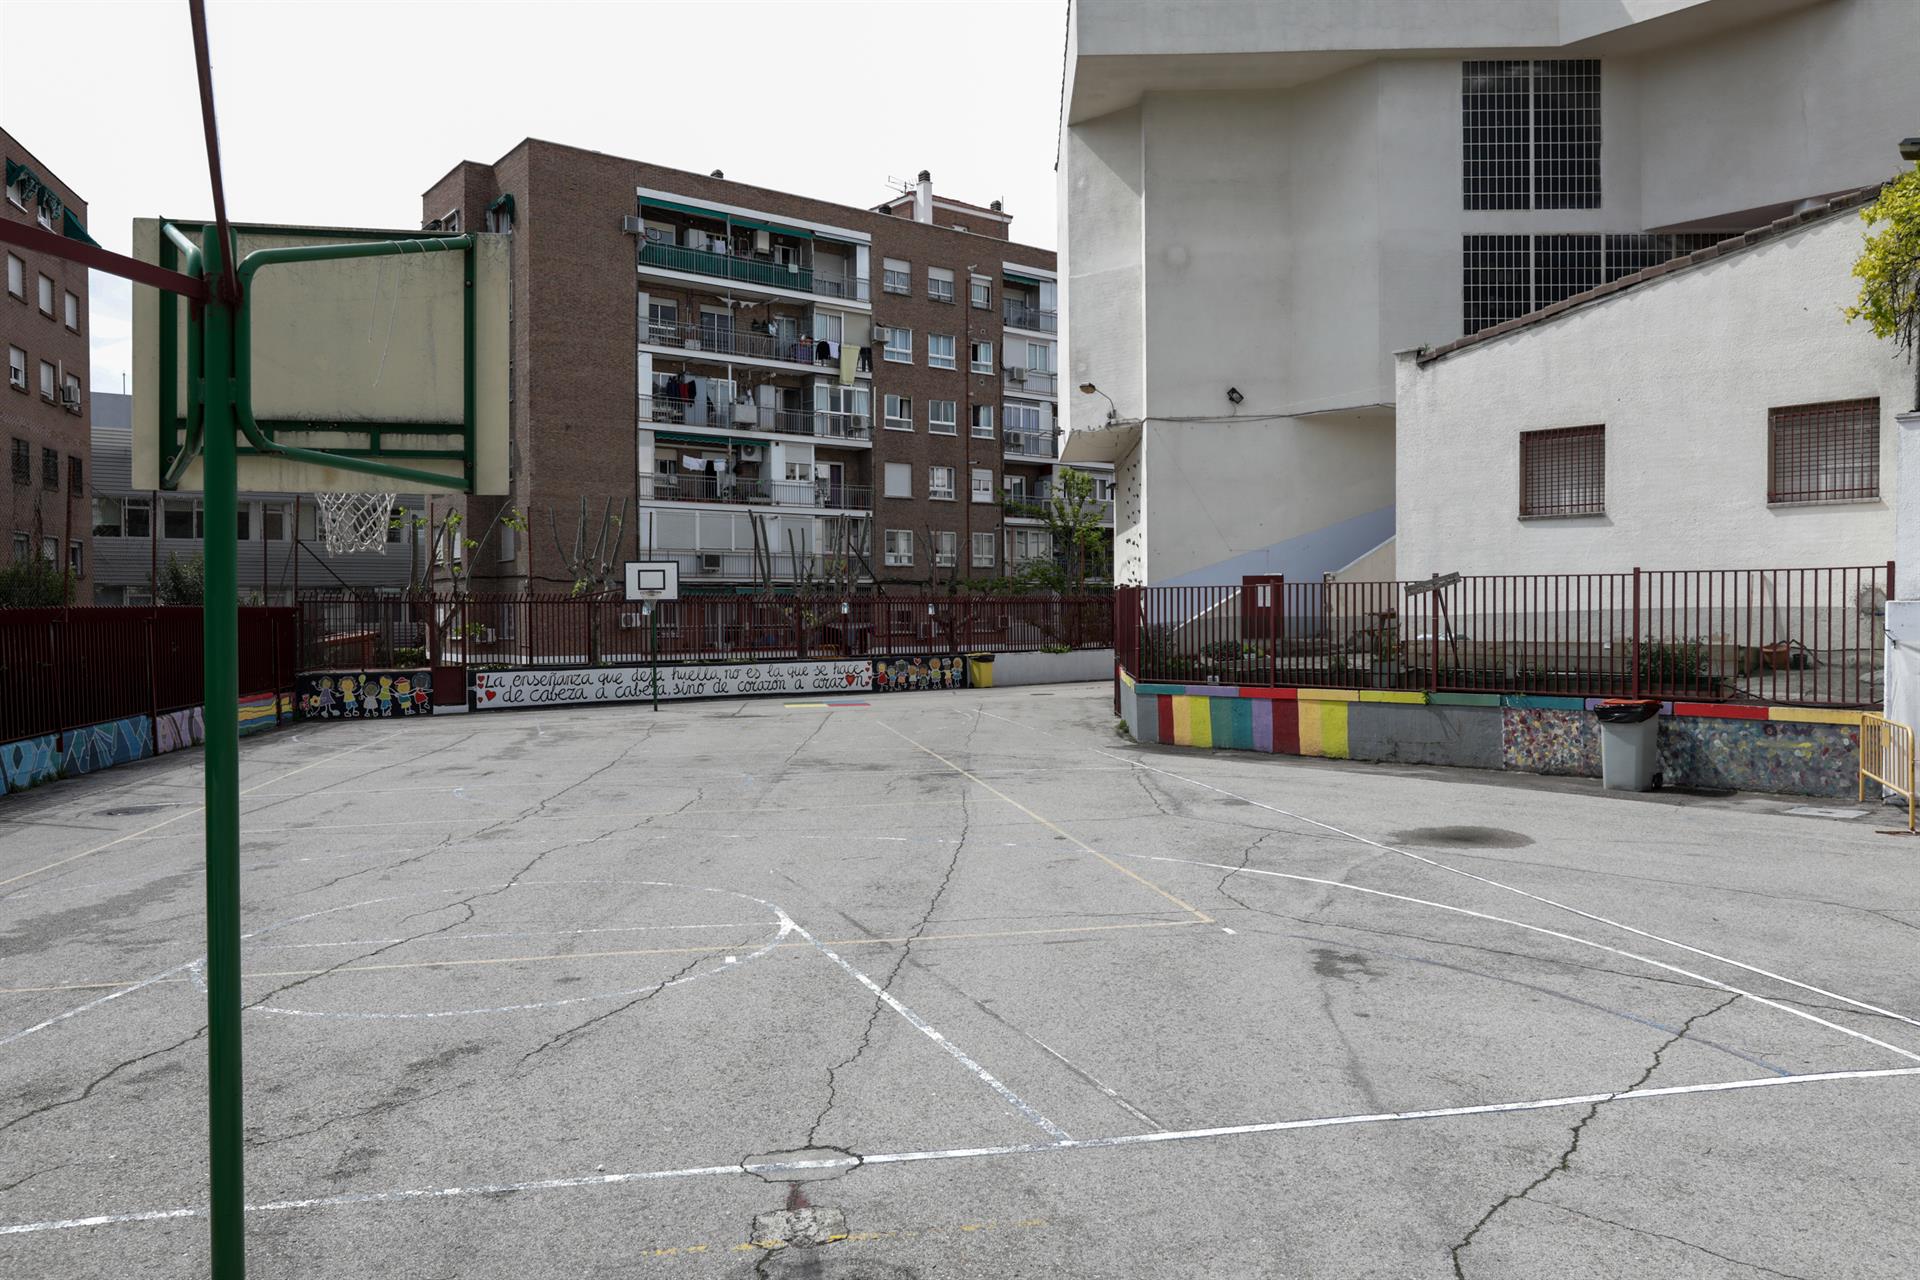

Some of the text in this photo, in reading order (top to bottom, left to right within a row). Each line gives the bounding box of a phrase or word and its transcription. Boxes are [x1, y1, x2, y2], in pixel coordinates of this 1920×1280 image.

[485, 675, 505, 688] La
[512, 672, 594, 687] enseñanza
[598, 672, 624, 686] que
[724, 668, 742, 679] no
[746, 667, 761, 679] es
[767, 664, 783, 677] la
[787, 665, 809, 678] que
[814, 664, 828, 677] se
[833, 662, 864, 675] hace
[502, 685, 525, 703] de
[529, 687, 588, 702] cabeza
[595, 686, 608, 699] a
[672, 681, 706, 696] sino
[713, 679, 729, 694] de
[794, 679, 804, 690] a
